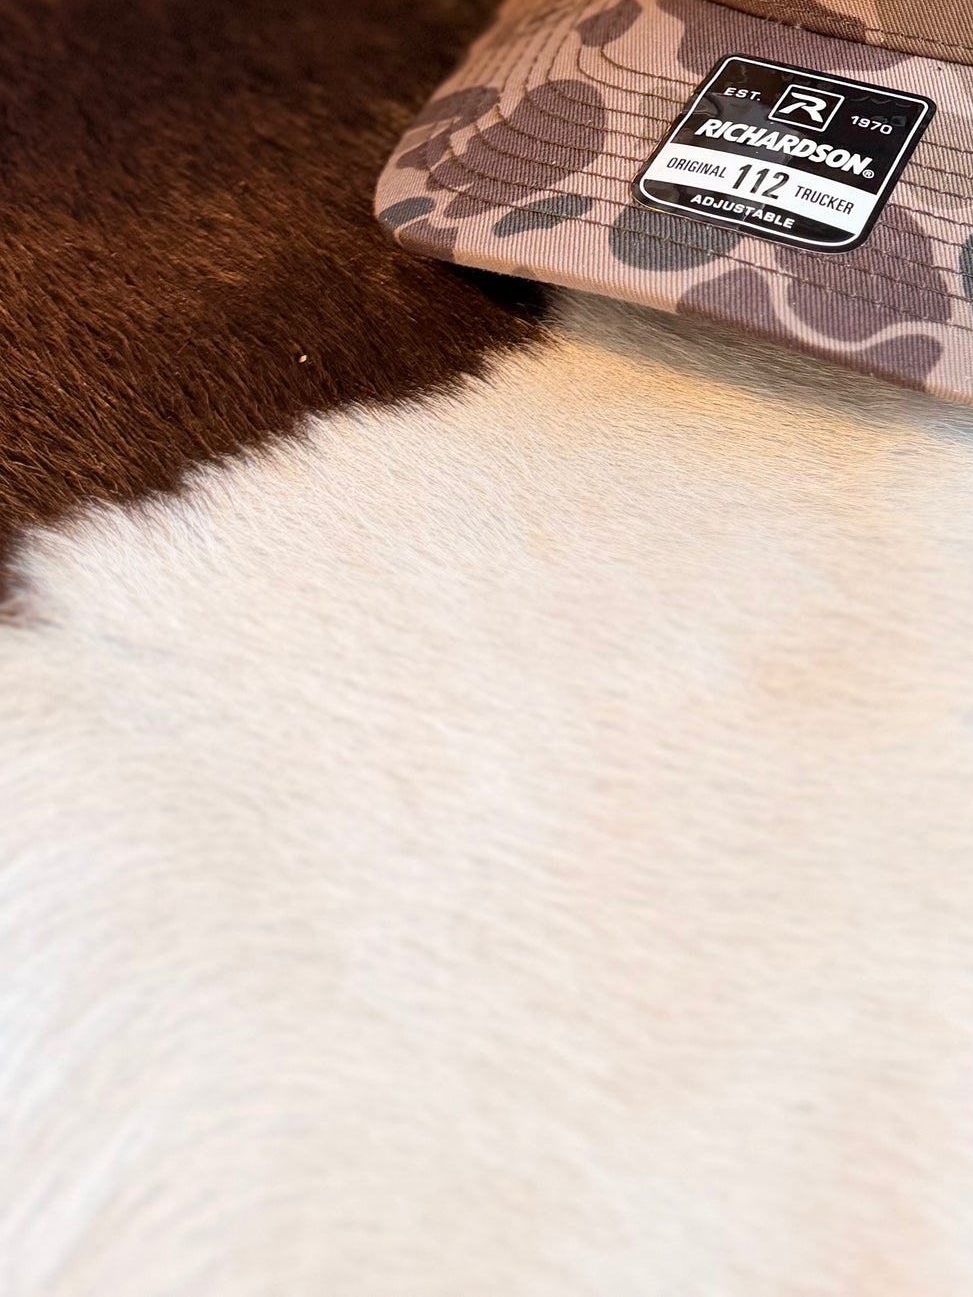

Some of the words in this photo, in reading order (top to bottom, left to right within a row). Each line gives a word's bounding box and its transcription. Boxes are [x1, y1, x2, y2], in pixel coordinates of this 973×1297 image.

[723, 86, 761, 101] EST.
[850, 115, 893, 135] 1970
[666, 156, 727, 179] ORIGINAL
[732, 164, 790, 200] 112
[794, 185, 855, 215] TRUCKER
[690, 193, 796, 229] ADJUSTABLE
